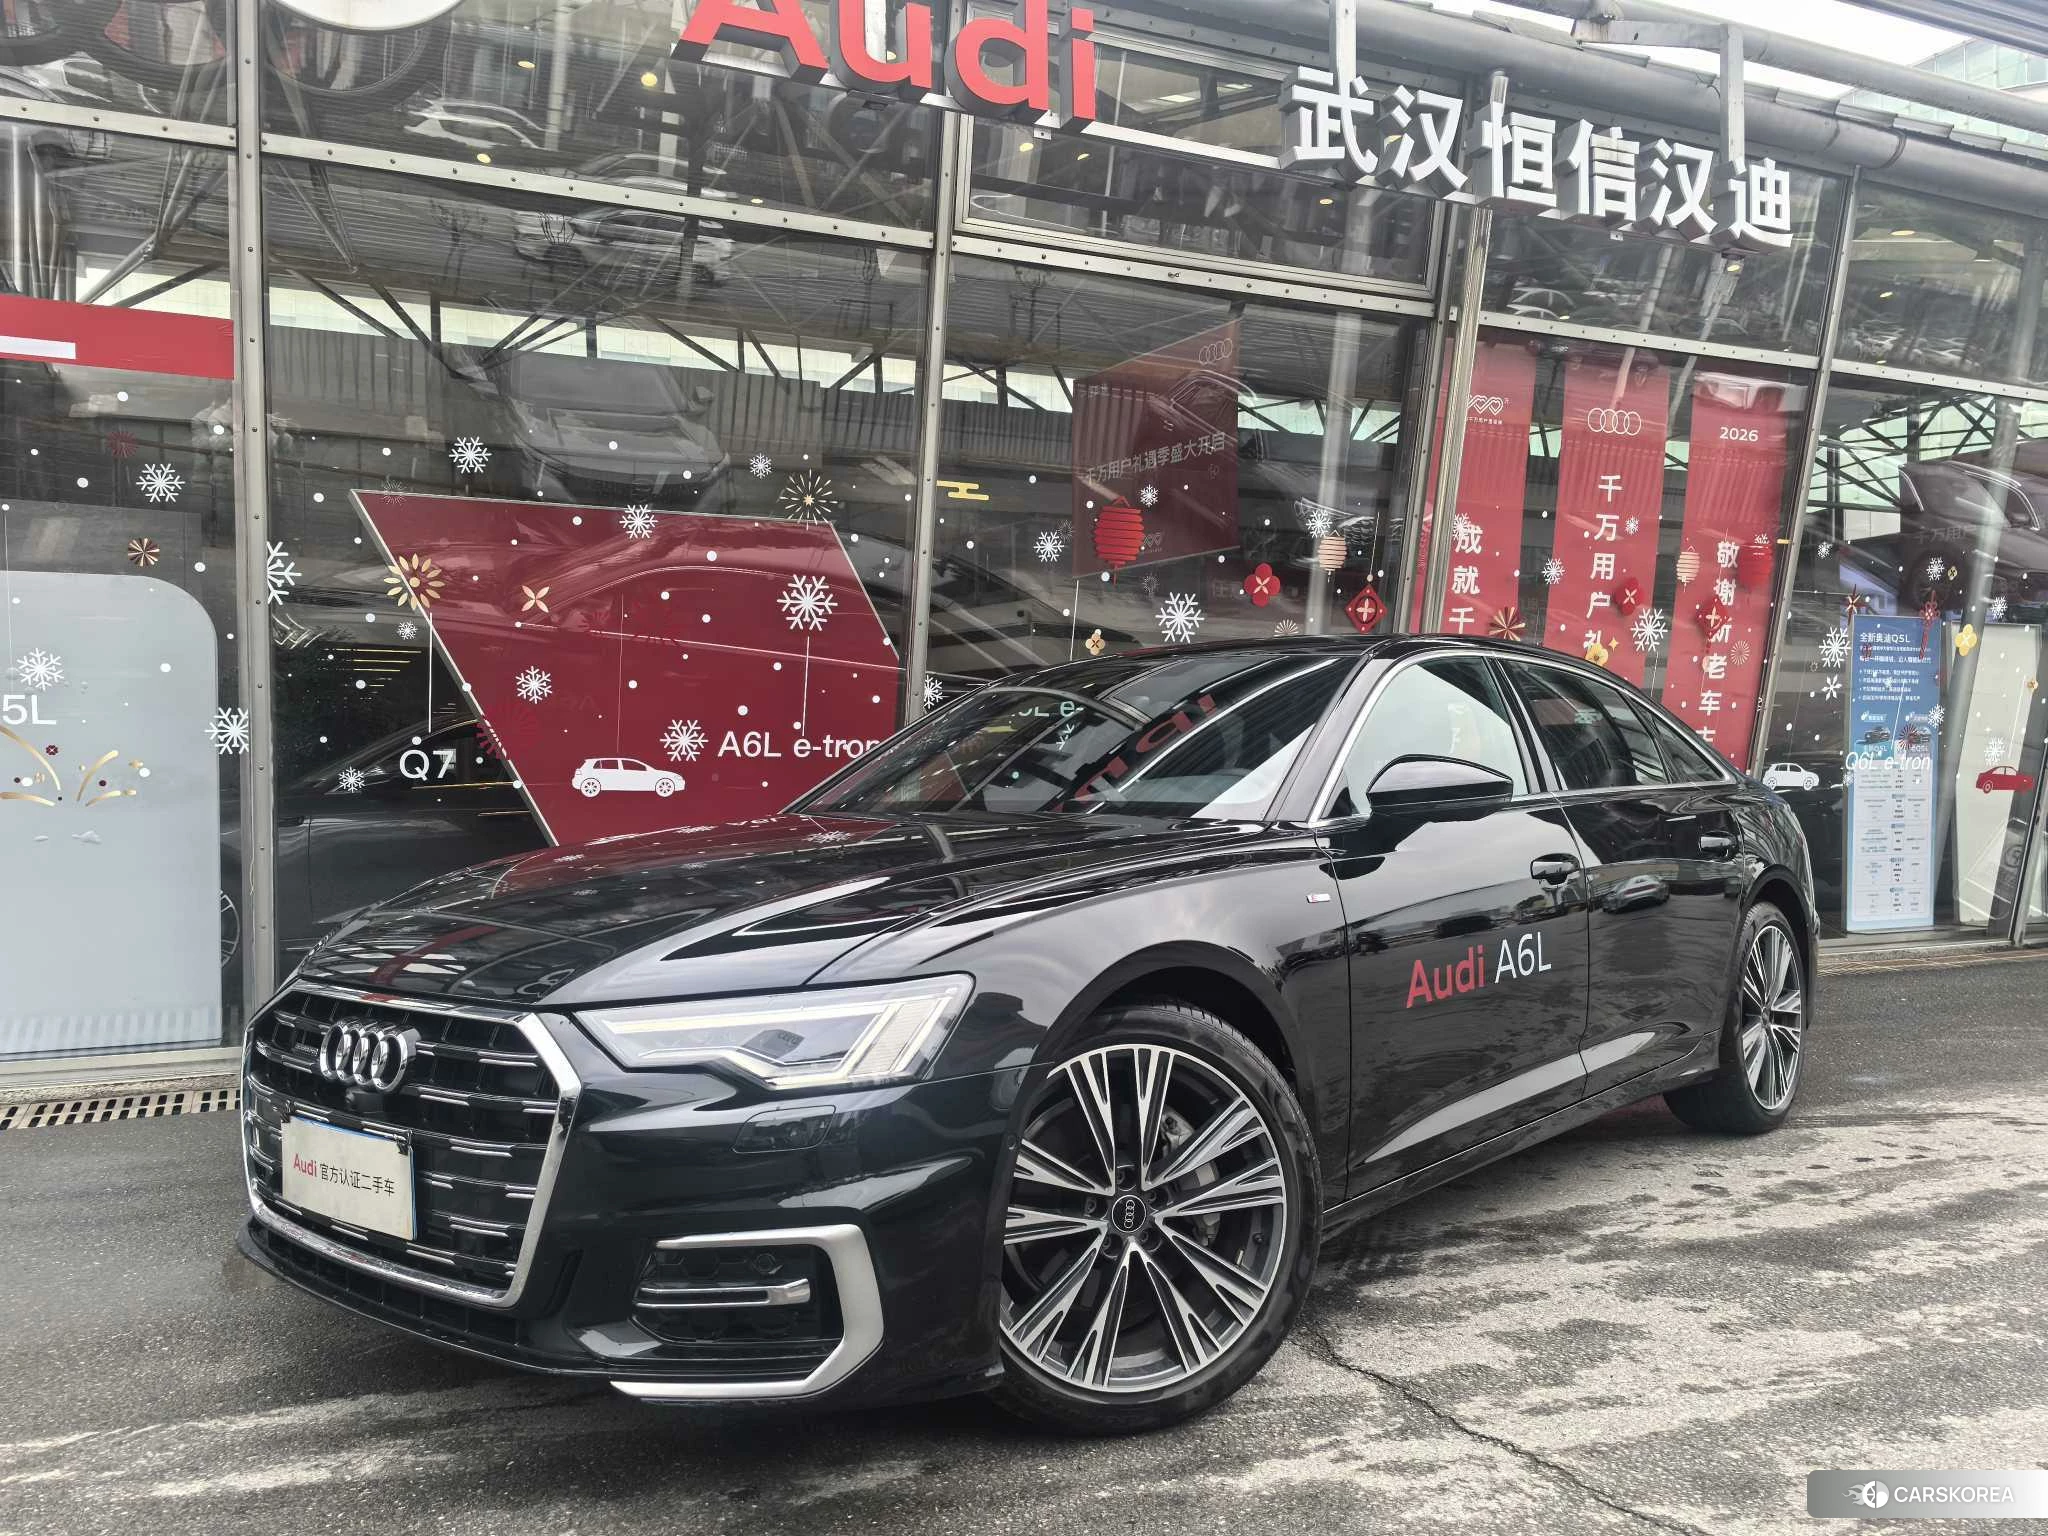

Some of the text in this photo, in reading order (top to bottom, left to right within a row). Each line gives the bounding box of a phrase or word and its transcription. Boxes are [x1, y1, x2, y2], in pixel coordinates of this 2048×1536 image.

[680, 0, 1096, 120] Audi
[1286, 65, 1793, 248] 武汉恒信汉迪
[1719, 426, 1760, 443] 2026
[2, 694, 57, 726] 5L
[718, 730, 782, 758] A6L
[399, 749, 454, 781] Q7
[1884, 754, 1931, 771] e-tron
[1406, 931, 1552, 1009] Audi A6L
[293, 1153, 396, 1198] Audi 官方认证二手车
